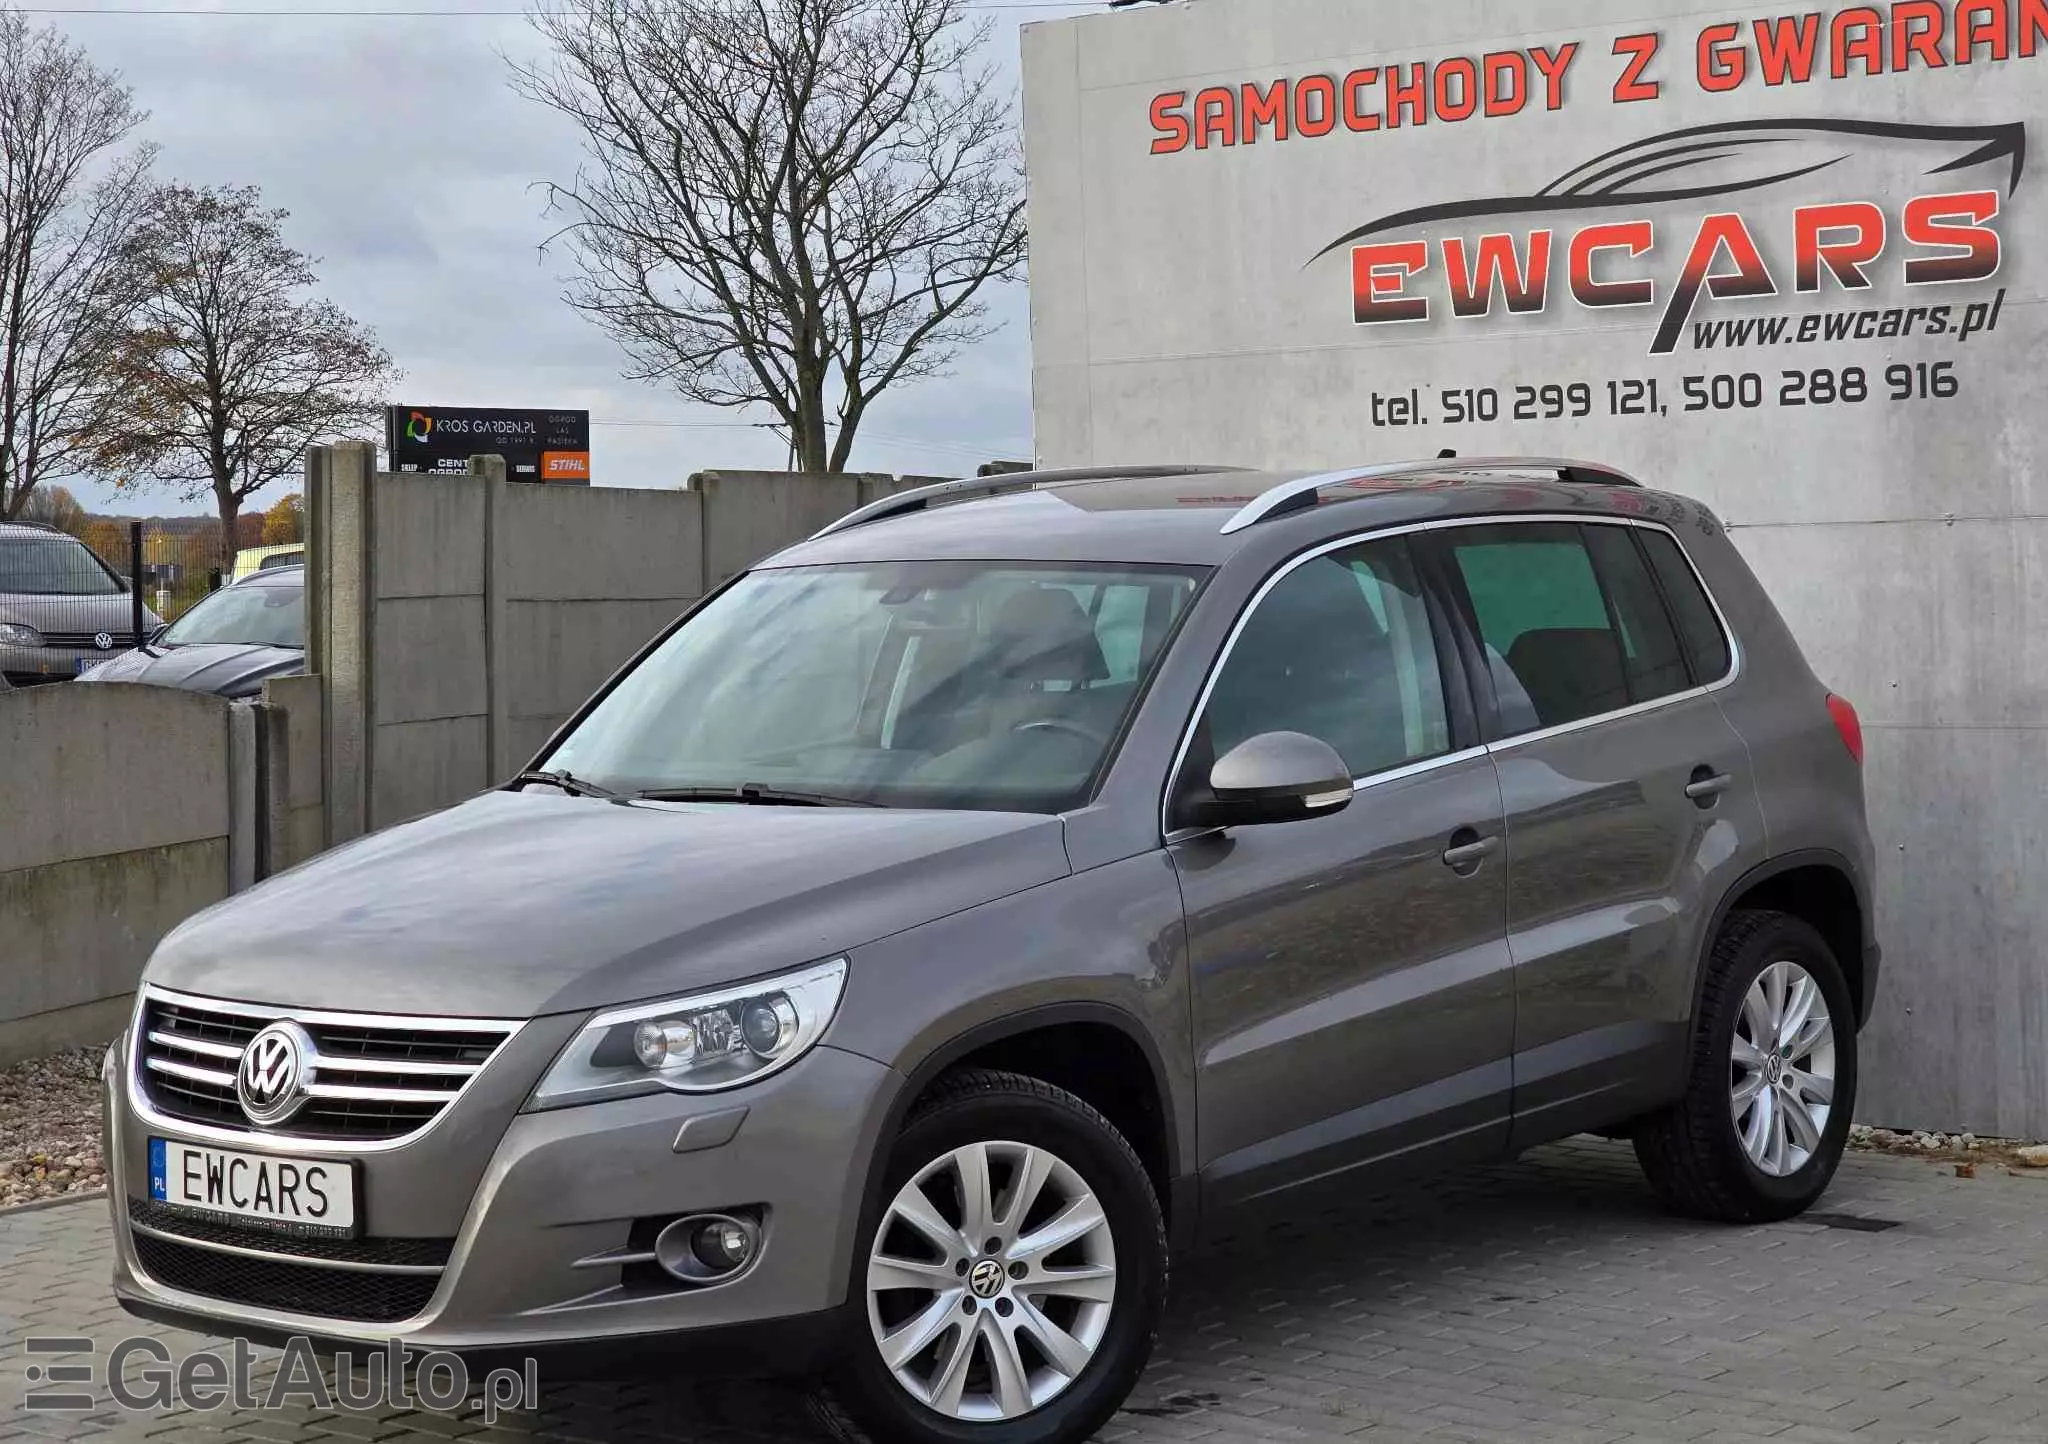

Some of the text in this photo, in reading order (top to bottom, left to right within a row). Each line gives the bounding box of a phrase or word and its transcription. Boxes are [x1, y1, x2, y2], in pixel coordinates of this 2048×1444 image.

[1150, 42, 1580, 155] SAMOCHODY
[1611, 32, 1659, 103] Z
[1350, 189, 2001, 357] EWCARS
[1694, 288, 2007, 349] www.ewcars.pl
[1371, 361, 1959, 426] tel. 510 299 121, 500 288 916
[436, 420, 537, 434] KROS GARDEN.PL
[549, 459, 585, 472] STIHL
[153, 1176, 166, 1192] PL
[183, 1149, 328, 1218] EWCARS
